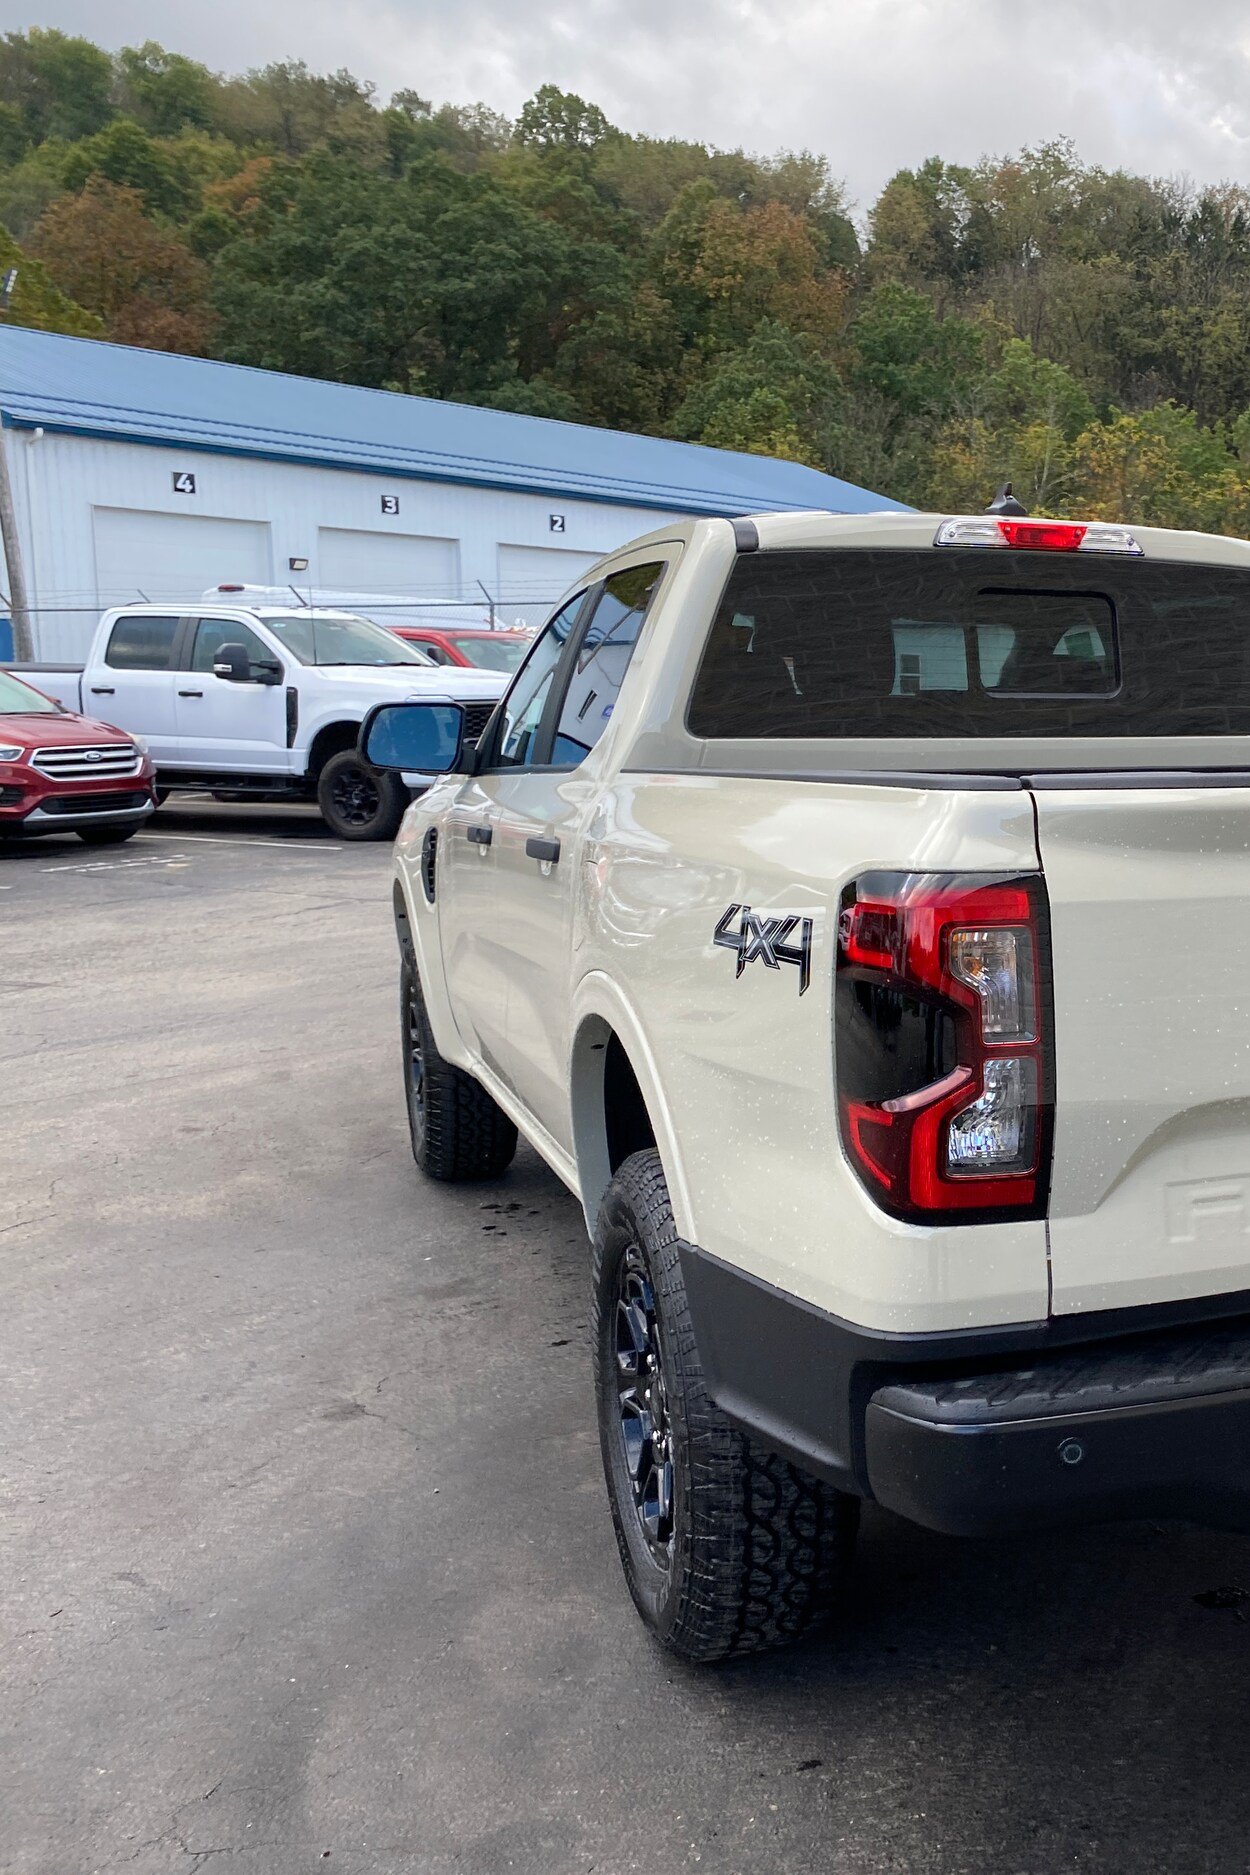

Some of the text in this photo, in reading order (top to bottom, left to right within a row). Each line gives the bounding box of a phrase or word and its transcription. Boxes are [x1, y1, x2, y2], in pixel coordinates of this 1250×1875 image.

[176, 473, 194, 493] 4
[384, 496, 397, 514] 3
[552, 515, 564, 531] 2
